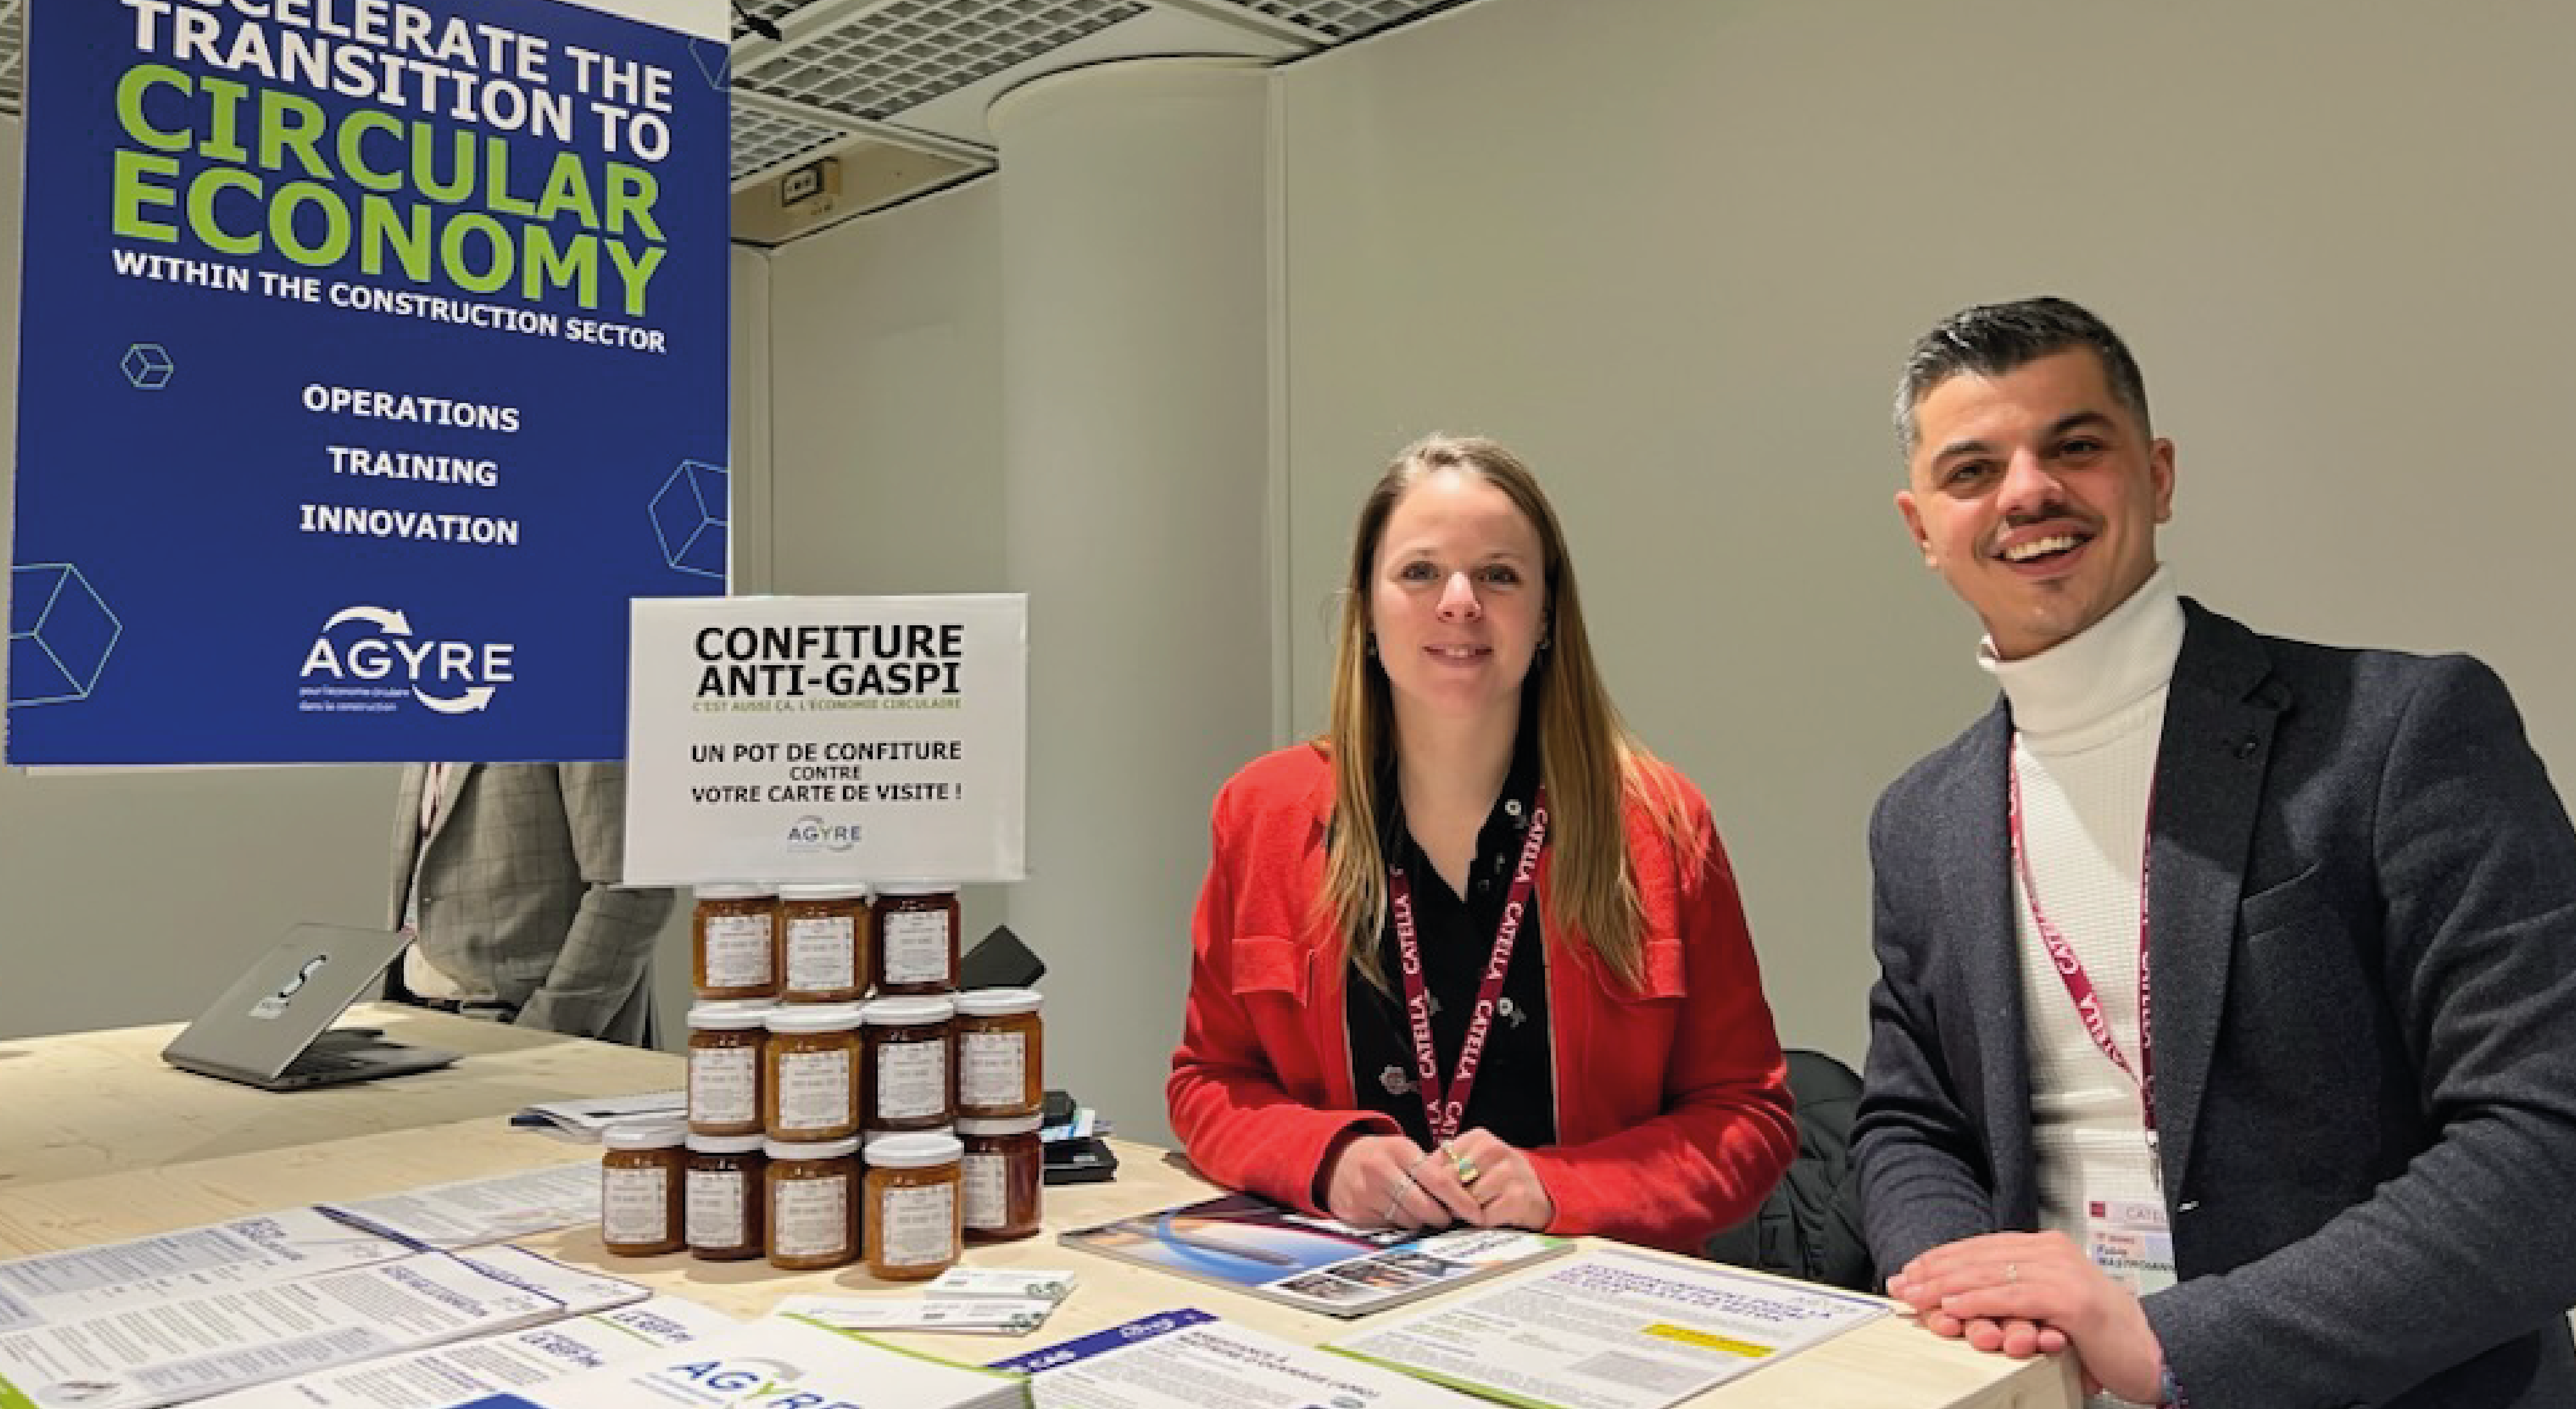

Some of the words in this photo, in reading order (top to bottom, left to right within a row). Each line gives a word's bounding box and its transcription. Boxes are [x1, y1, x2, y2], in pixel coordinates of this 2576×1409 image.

[122, 0, 570, 140] TRANSITION
[591, 103, 669, 162] TO
[192, 0, 549, 84] ELERATE
[565, 46, 672, 113] THE
[117, 65, 664, 242] CIRCULAR
[113, 148, 667, 317] ECONOMY
[112, 250, 249, 290] WITHIN
[259, 272, 321, 301] THE
[329, 282, 556, 336] CONSTRUCTION
[565, 317, 666, 353] SECTOR
[302, 383, 519, 432] OPERATIONS
[326, 446, 498, 486] TRAINING
[299, 505, 518, 545] INNOVATION
[299, 638, 515, 682] AGYRE
[696, 625, 964, 660] CONFITURE
[697, 663, 961, 697] ANTI-GASPI
[693, 746, 723, 762] UN
[734, 743, 780, 762] POT
[787, 743, 817, 762] DE
[824, 741, 961, 762] CONFITURE
[789, 766, 862, 781] CONTRE
[692, 785, 761, 803] VOTRE
[768, 784, 836, 802] CARTE
[843, 784, 869, 802] DE
[877, 783, 949, 800] VISITE
[955, 783, 962, 800] !
[787, 826, 862, 842] AGYRE
[1515, 809, 1548, 884] CATELLA
[1394, 893, 1419, 974] CATELLA
[1486, 902, 1525, 979] CATELLA
[1408, 994, 1436, 1079] CATELLA
[1455, 999, 1494, 1081] CATELLA
